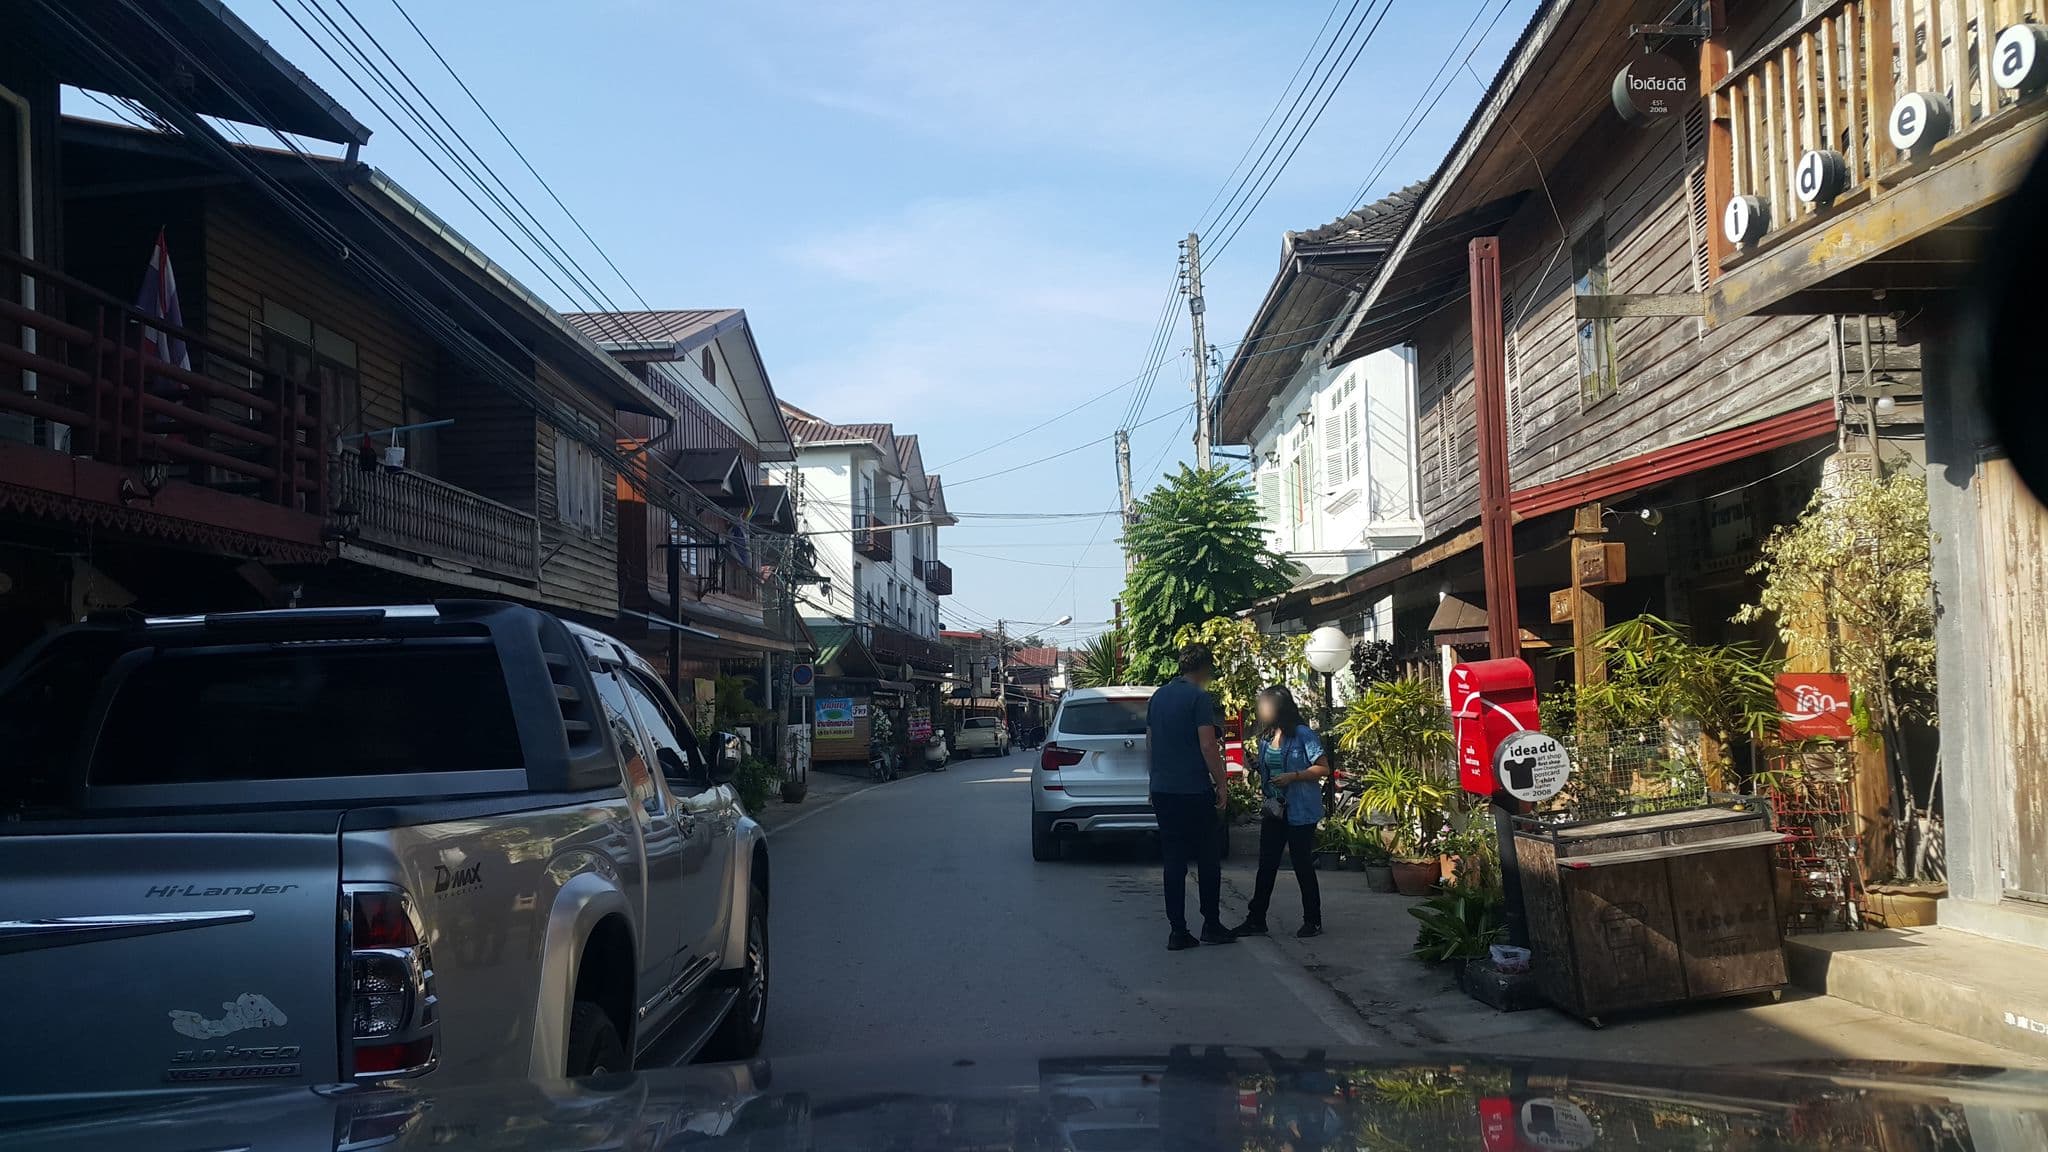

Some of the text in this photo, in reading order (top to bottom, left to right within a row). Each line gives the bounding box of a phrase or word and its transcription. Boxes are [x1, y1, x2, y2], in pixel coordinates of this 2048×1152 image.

[1510, 741, 1556, 757] idea dd
[1534, 769, 1561, 778] postcard
[1532, 789, 1552, 797] 2008
[145, 883, 299, 899] Hi-Lander
[213, 1065, 298, 1079] TURBO
